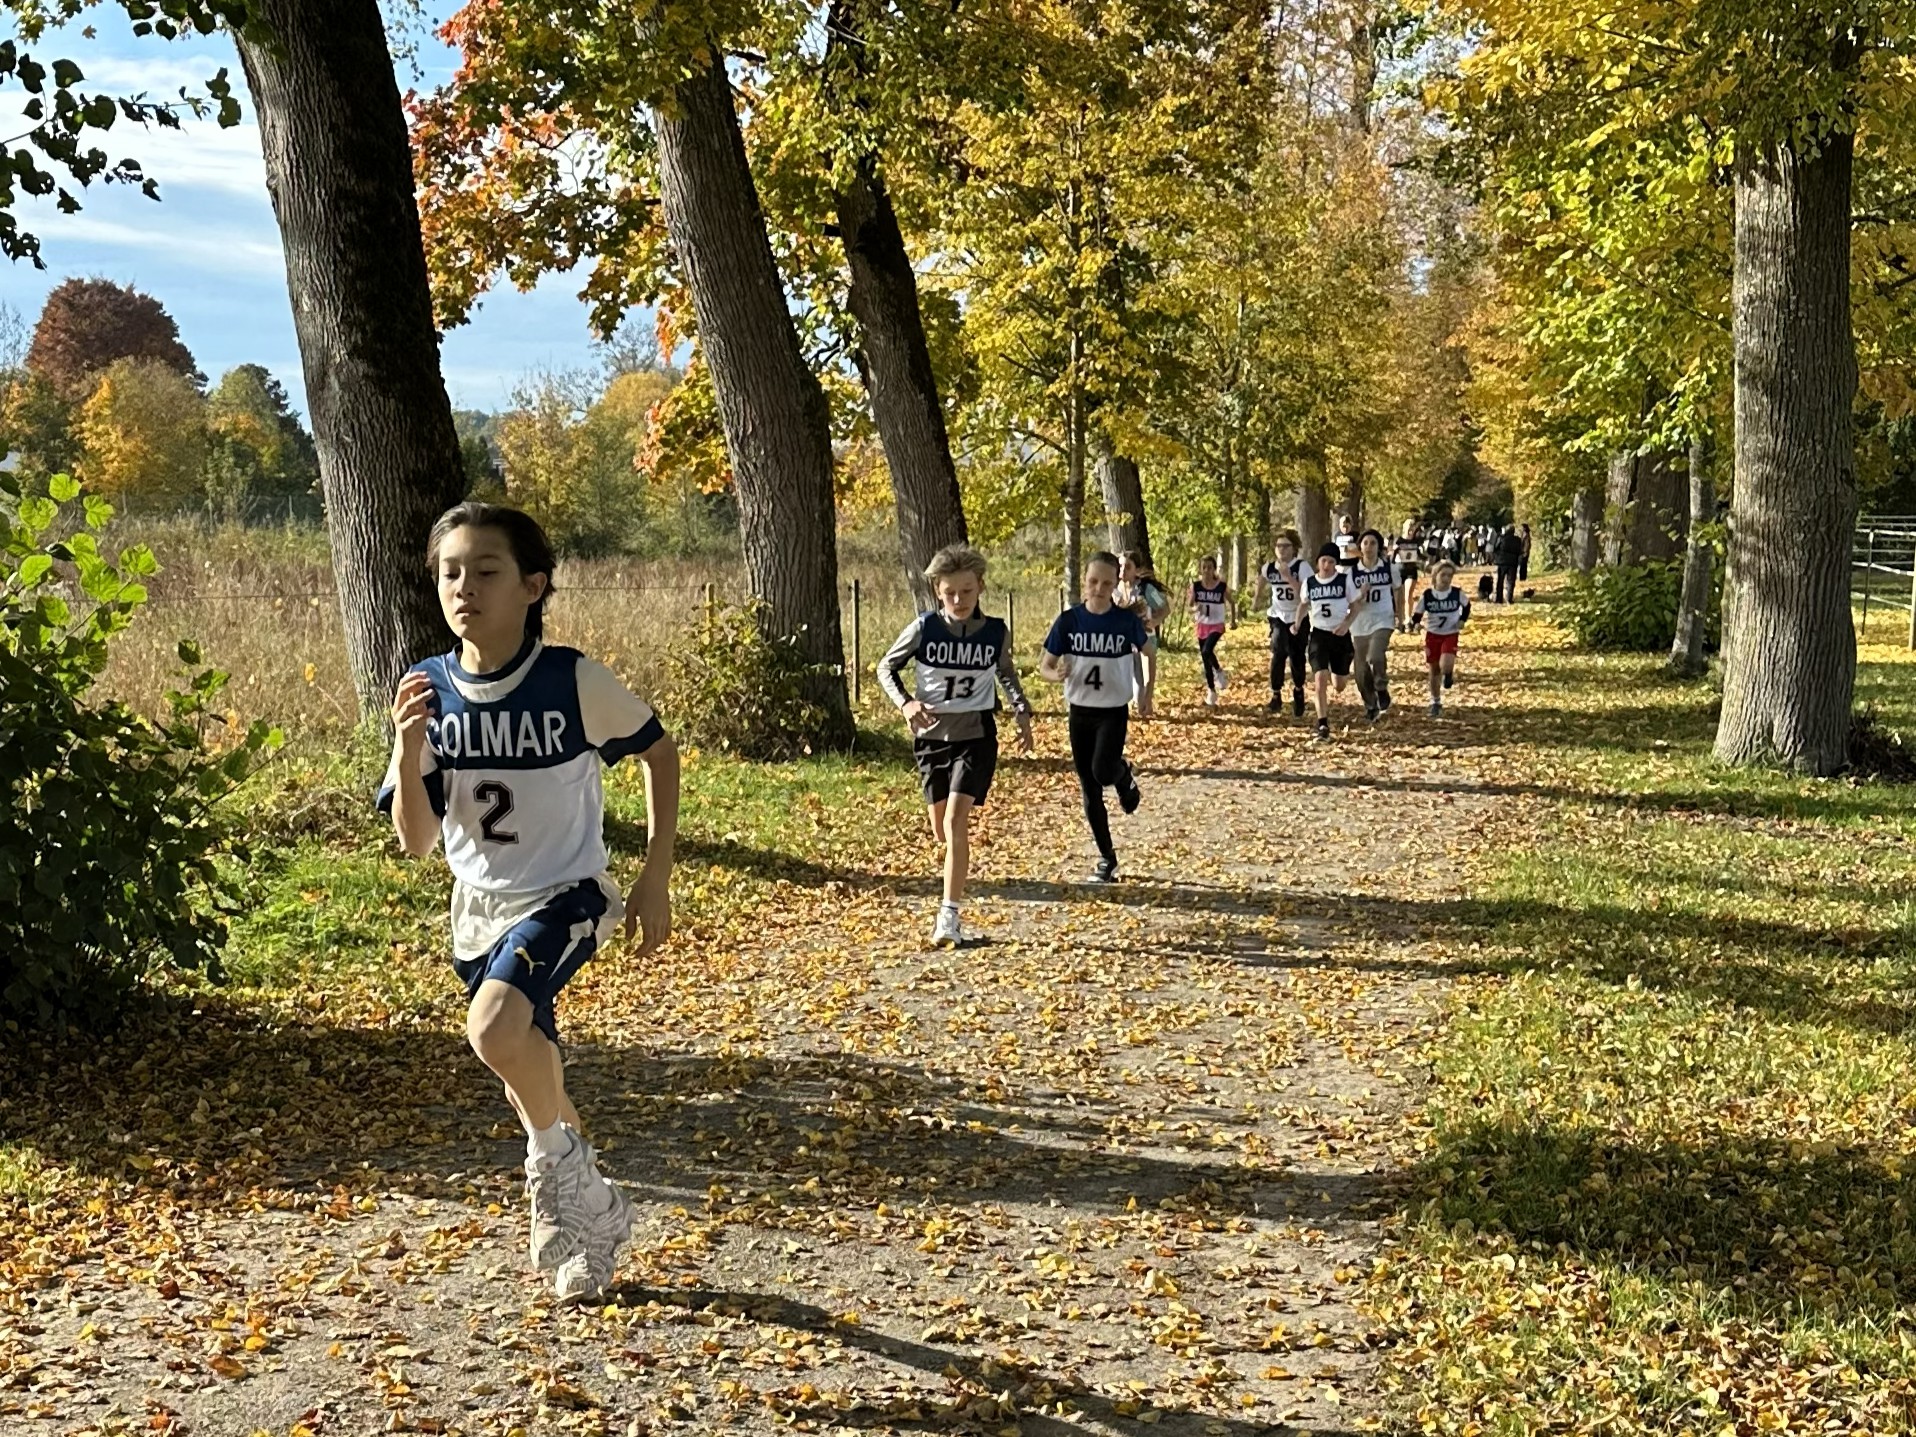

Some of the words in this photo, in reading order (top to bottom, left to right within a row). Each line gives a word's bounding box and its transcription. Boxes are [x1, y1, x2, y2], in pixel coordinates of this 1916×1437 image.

[1355, 572, 1390, 586] COLMAR
[1276, 587, 1294, 601] 26
[1310, 585, 1344, 599] COLMAR
[1366, 589, 1380, 603] 10
[1206, 604, 1210, 617] 1
[1321, 603, 1332, 618] 5
[1426, 600, 1458, 611] COLMAR
[1438, 616, 1447, 628] 7
[926, 641, 995, 666] COLMAR
[1084, 665, 1103, 691] 4
[943, 676, 976, 701] 13
[425, 710, 567, 758] COLMAR
[472, 779, 519, 846] 2
